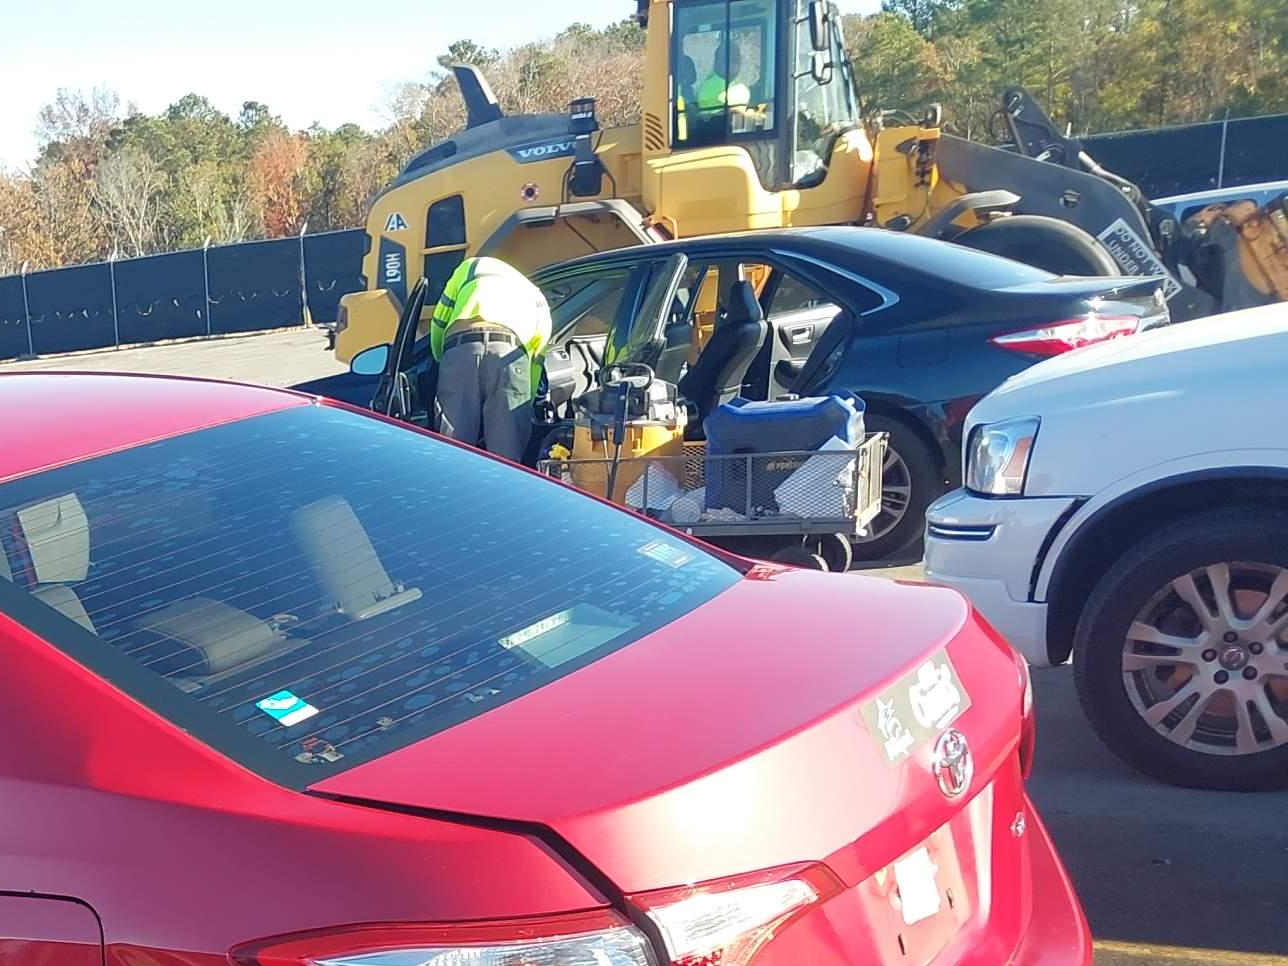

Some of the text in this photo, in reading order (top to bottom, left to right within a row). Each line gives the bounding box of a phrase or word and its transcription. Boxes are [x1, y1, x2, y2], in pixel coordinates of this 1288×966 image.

[517, 141, 577, 157] VOLV
[1128, 242, 1151, 264] NOT
[385, 252, 402, 283] L90H
